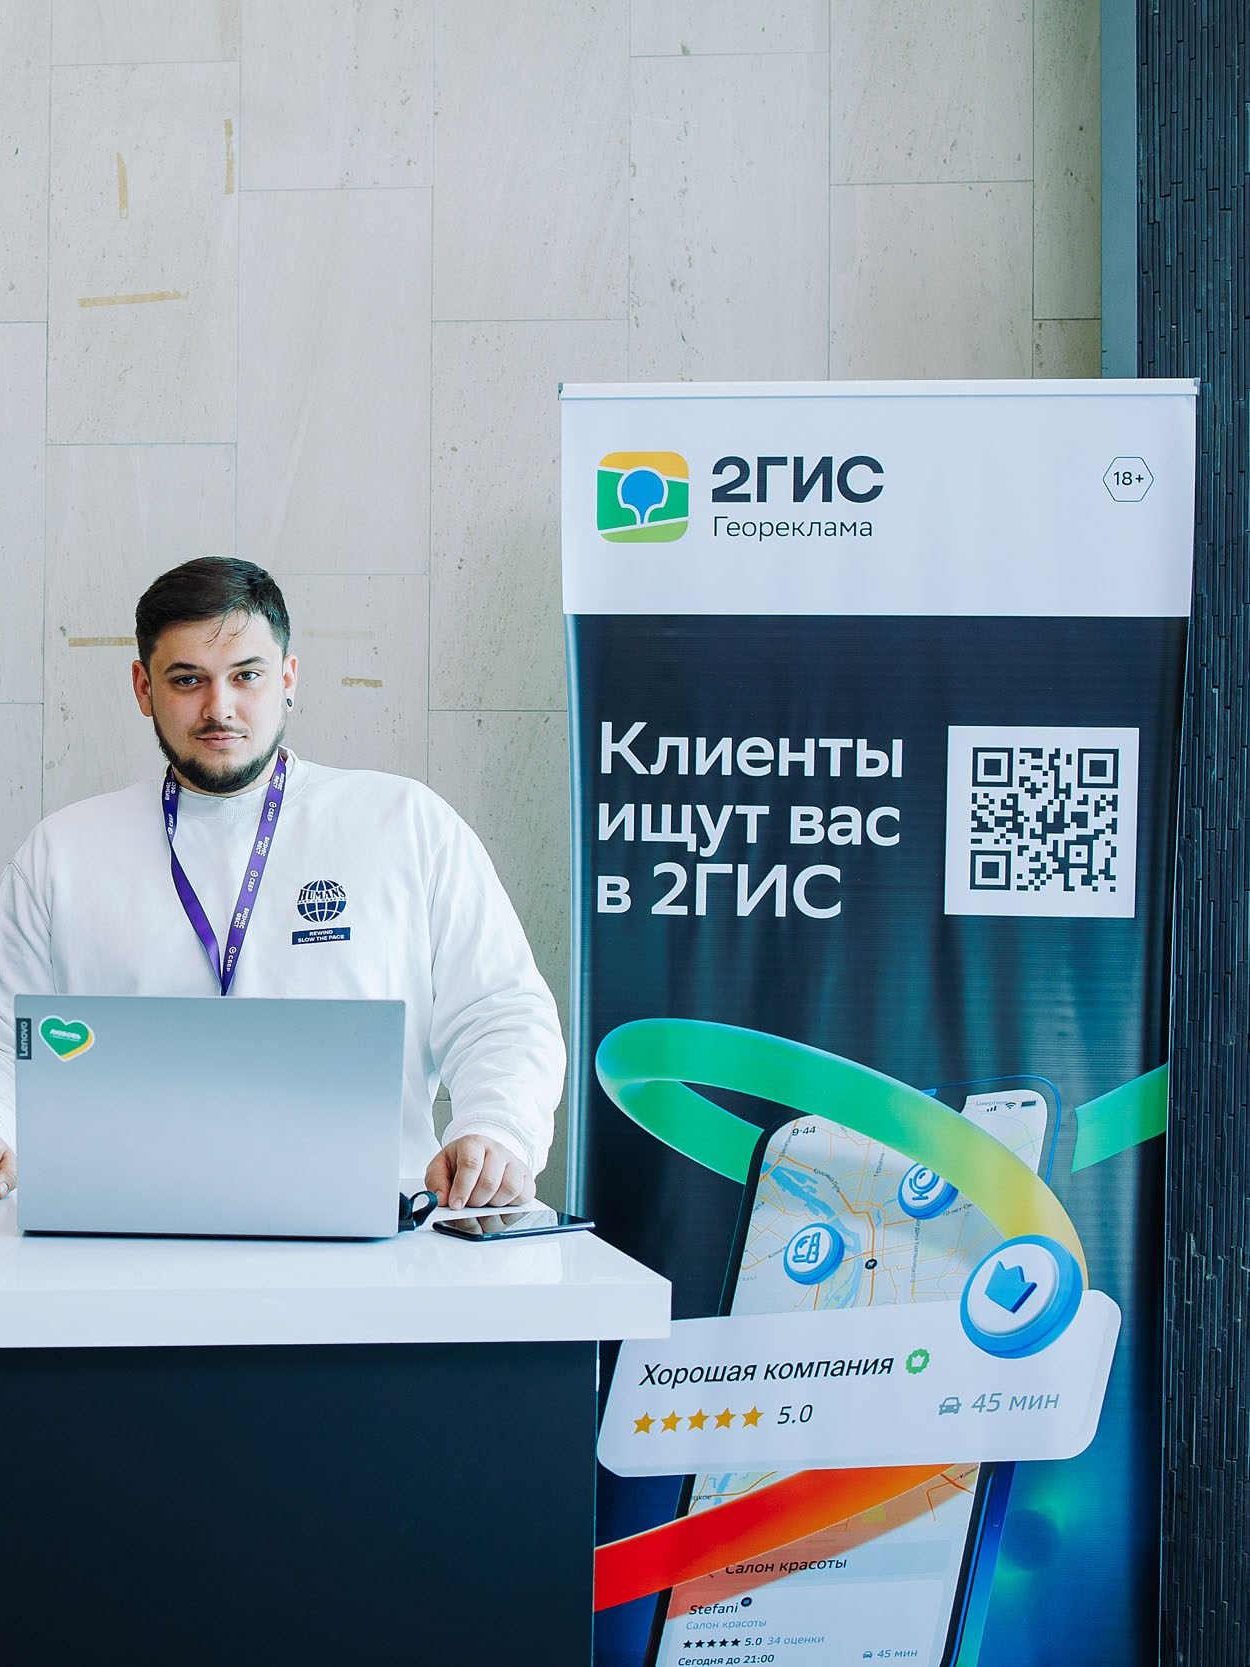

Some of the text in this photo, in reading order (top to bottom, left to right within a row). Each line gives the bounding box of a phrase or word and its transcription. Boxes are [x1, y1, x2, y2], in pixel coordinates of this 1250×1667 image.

[711, 455, 885, 504] 2ГИС
[1112, 471, 1145, 487] 18+
[712, 516, 873, 542] Геореклама
[599, 721, 904, 779] Клиенты
[598, 803, 901, 856] ищут вас
[298, 885, 347, 901] HUMANS
[597, 863, 843, 919] в 2ГИС
[19, 1021, 28, 1057] Lenovo
[638, 1355, 894, 1389] Хорошая компания
[970, 1391, 1060, 1414] 45 мин
[776, 1404, 813, 1426] 5.0
[725, 1558, 847, 1575] Салон красоты
[688, 1603, 739, 1616] Stefani
[686, 1618, 767, 1631] Салон красоты
[744, 1635, 825, 1647] 5.0 34 оценки
[678, 1654, 775, 1667] Сегодня до 21:00
[877, 1649, 918, 1659] 45 мин
